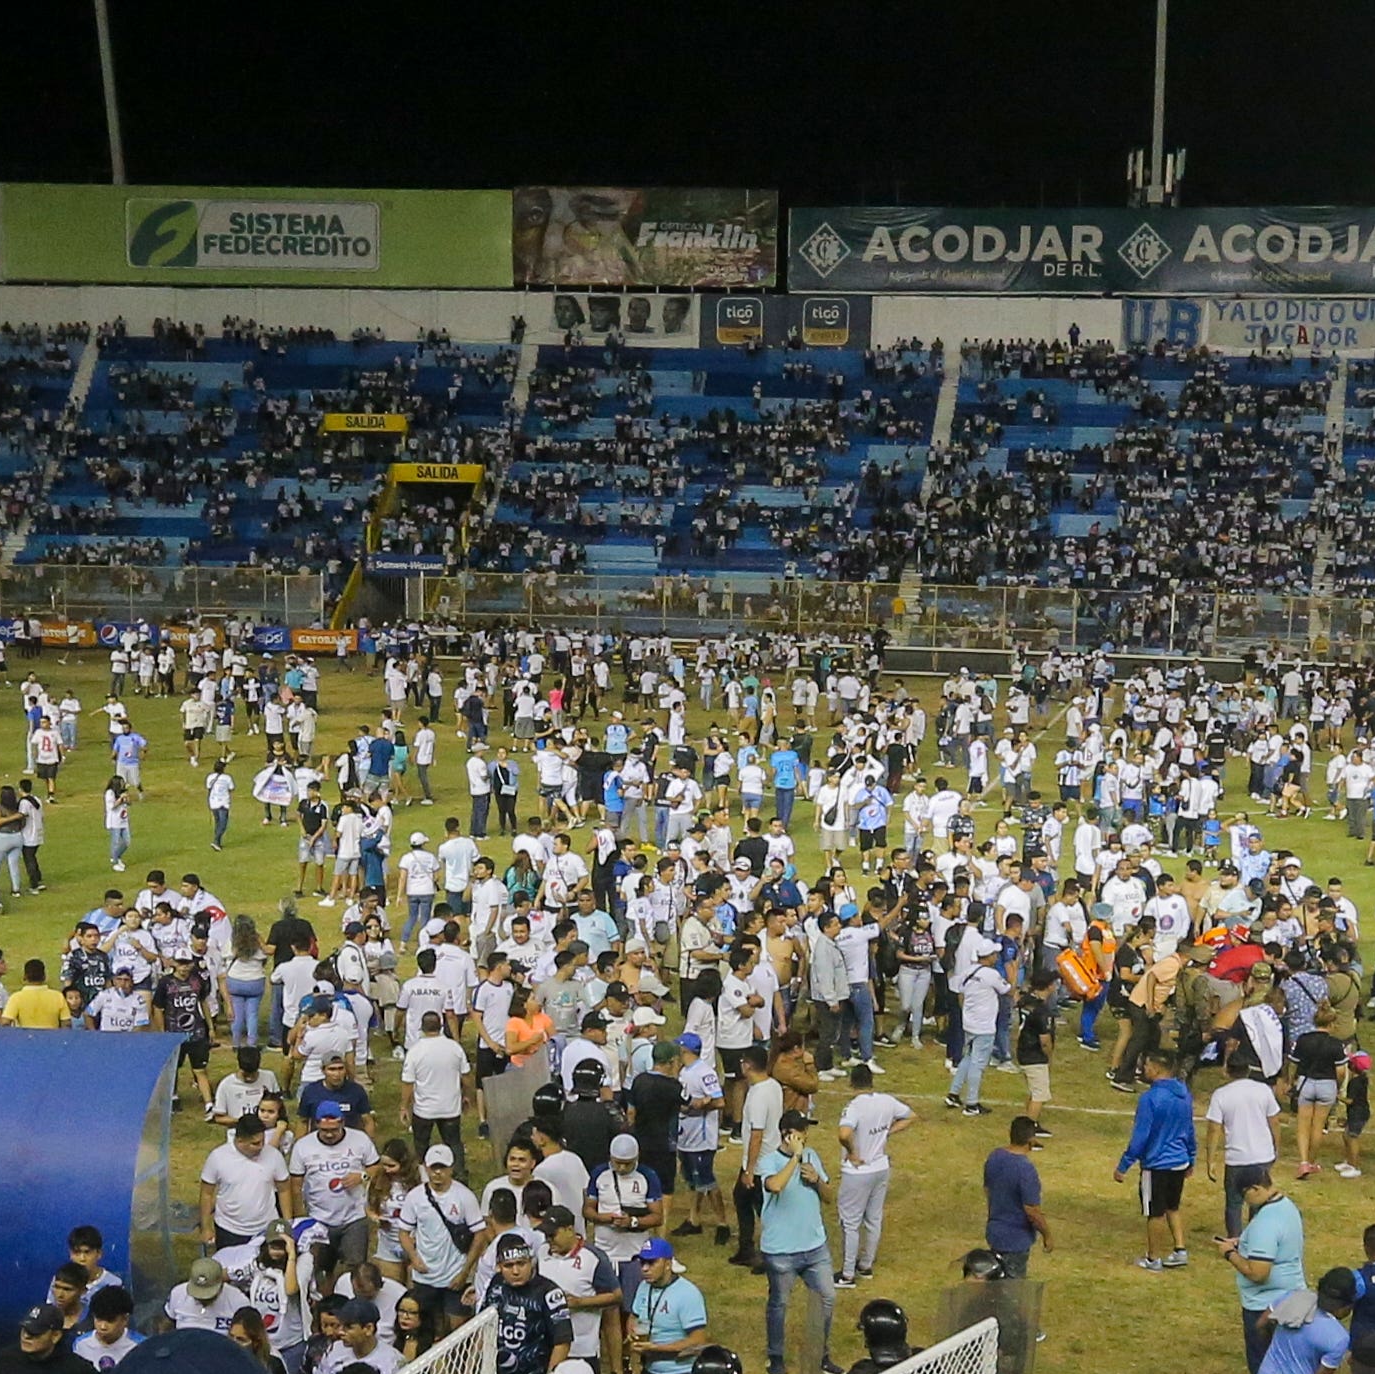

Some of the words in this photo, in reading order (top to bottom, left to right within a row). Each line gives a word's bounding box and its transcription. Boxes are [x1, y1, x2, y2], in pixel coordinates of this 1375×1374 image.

[229, 212, 345, 235] SISTEMA
[203, 234, 371, 257] FEDECREDITO
[636, 222, 758, 249] Franklin
[861, 225, 1104, 263] ACODJAR
[1044, 262, 1067, 277] DE
[345, 415, 386, 429] SALIDA
[416, 465, 459, 480] SALIDA
[410, 988, 441, 997] ABANK
[318, 1160, 351, 1178] tigo
[497, 1319, 526, 1349] igo
